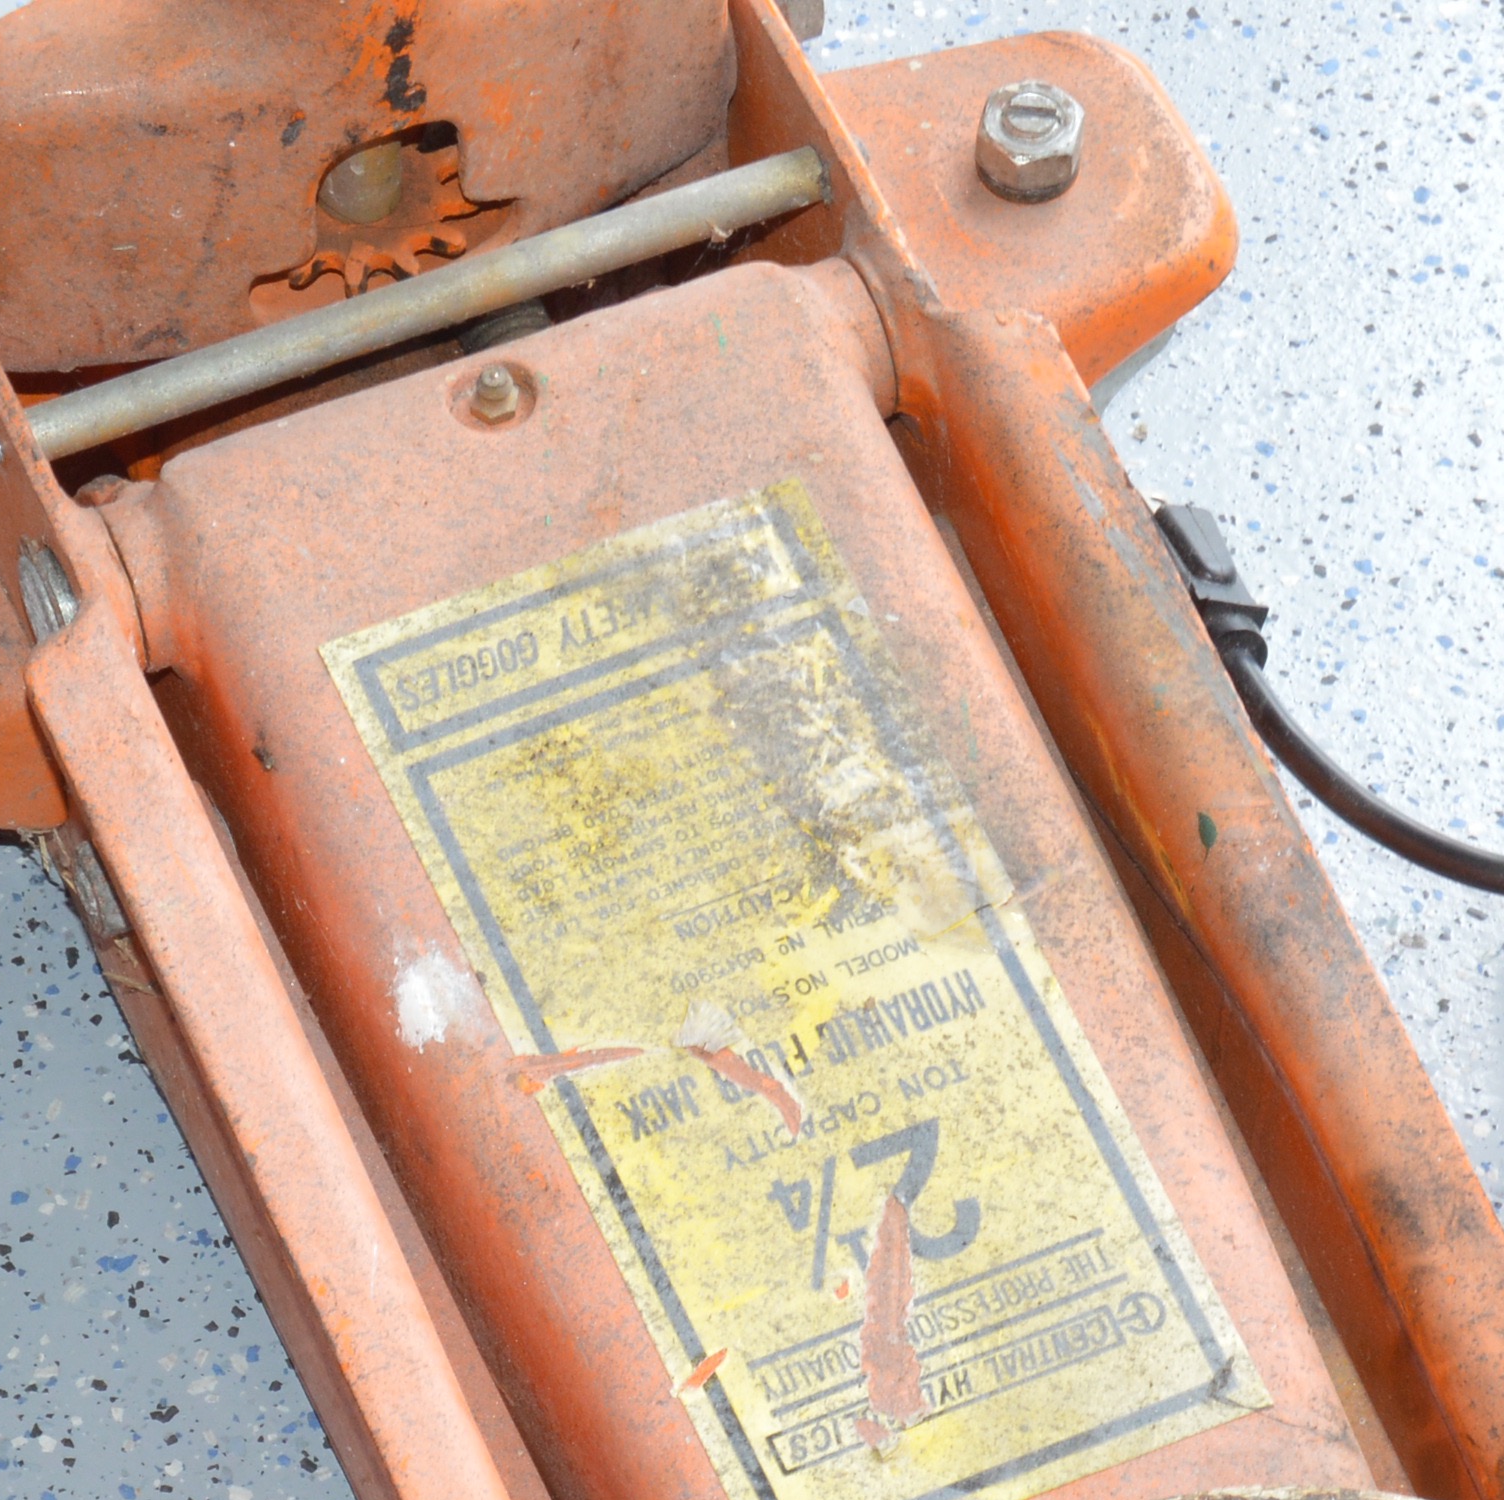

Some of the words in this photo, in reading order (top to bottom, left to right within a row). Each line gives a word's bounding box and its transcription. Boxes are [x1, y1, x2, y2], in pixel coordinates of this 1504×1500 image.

[385, 628, 548, 714] GOGGLES
[671, 882, 797, 944] CAUTION
[811, 895, 901, 942] SERIAL
[832, 935, 921, 980] MODEL
[810, 967, 989, 1066] HYDRAULIC
[612, 1072, 710, 1142] JACK
[895, 1055, 970, 1102] TON
[714, 1086, 887, 1172] CAPACITY
[1056, 1242, 1115, 1285] THE
[754, 1338, 865, 1403] QUALITY
[981, 1314, 1113, 1385] CENTRAL
